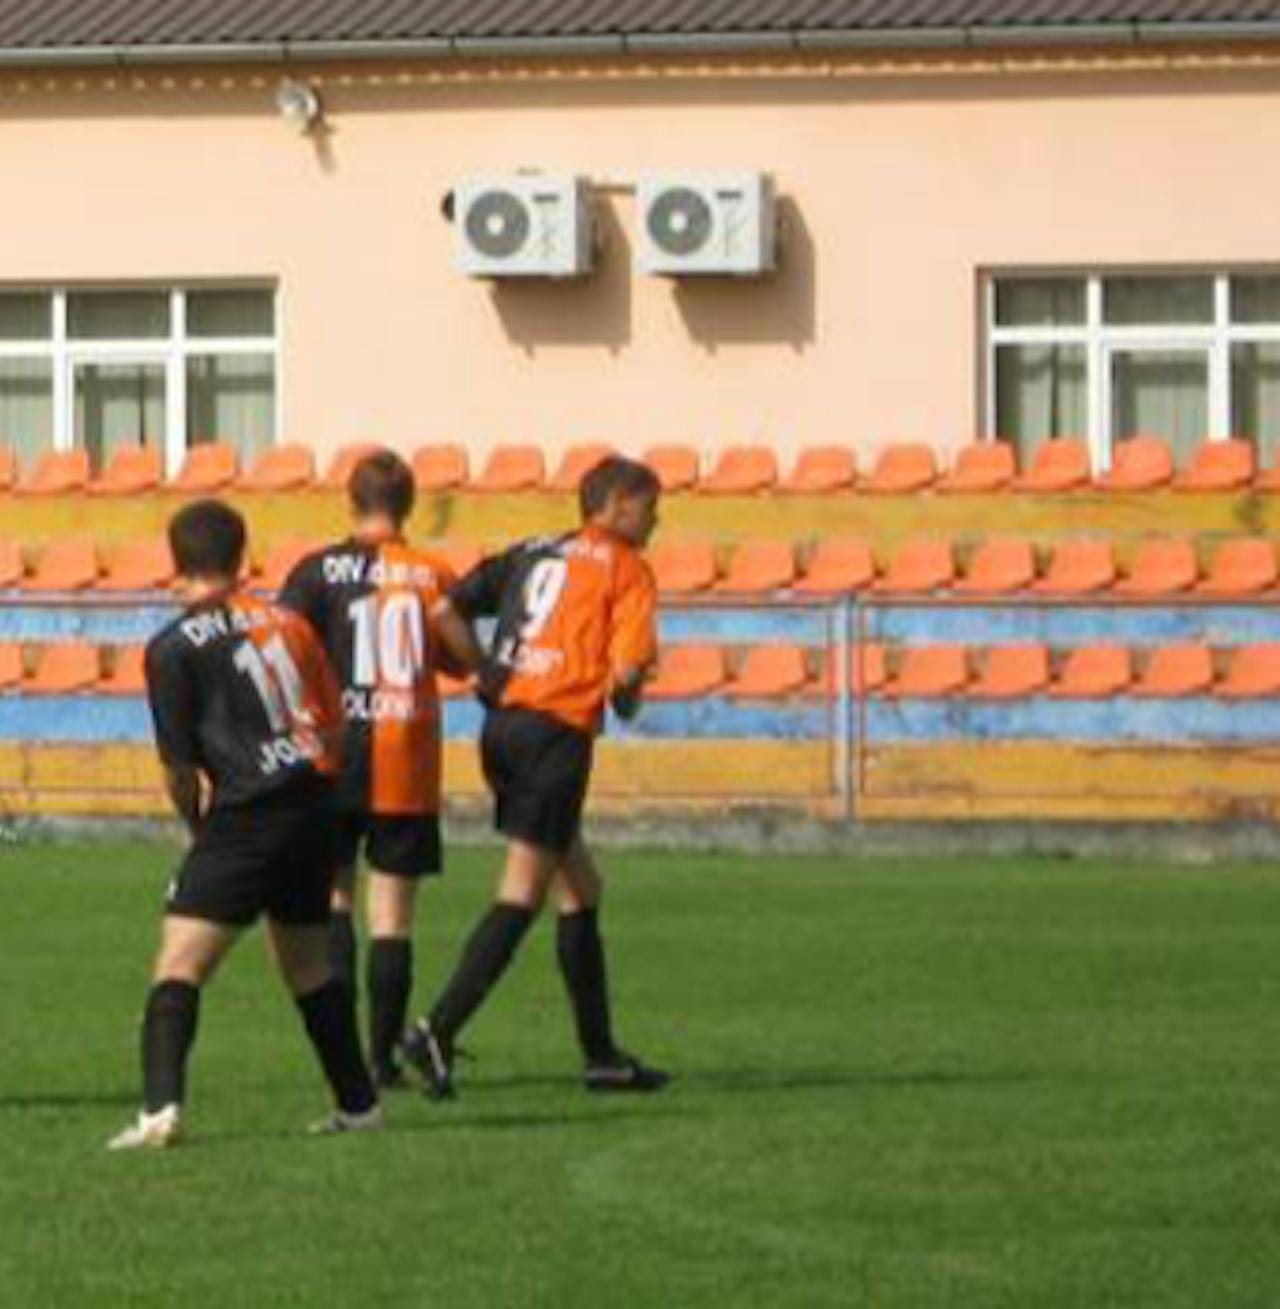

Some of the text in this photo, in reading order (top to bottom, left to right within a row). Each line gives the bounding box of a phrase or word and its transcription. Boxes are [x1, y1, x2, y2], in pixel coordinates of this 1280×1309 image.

[348, 592, 425, 688] 10
[521, 557, 568, 640] 9
[232, 633, 315, 732] 11
